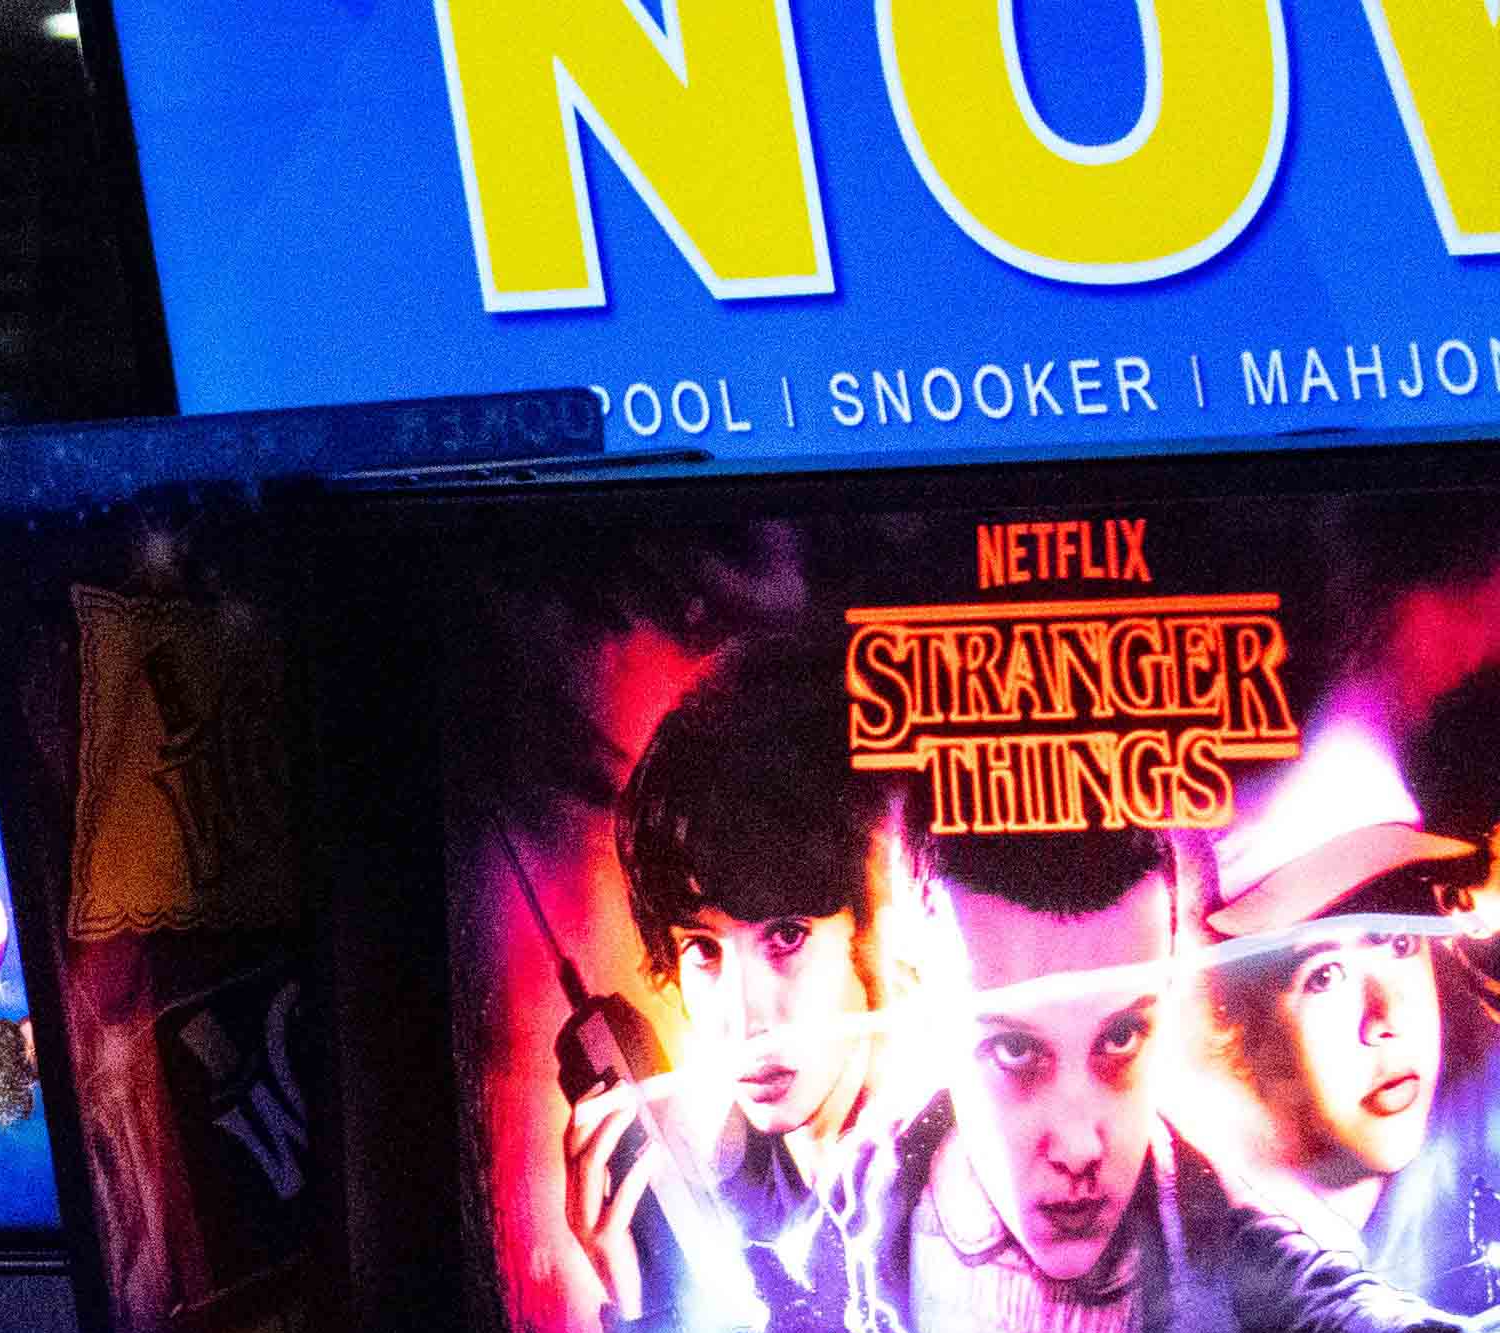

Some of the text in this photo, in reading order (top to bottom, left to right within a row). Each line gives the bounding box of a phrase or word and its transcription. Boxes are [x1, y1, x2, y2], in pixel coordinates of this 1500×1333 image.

[434, 0, 1500, 313] NO
[830, 355, 1159, 429] SNOOKER
[1240, 336, 1500, 407] MAHJO
[977, 519, 1151, 589] NETFLIX
[846, 615, 1298, 750] STRANGER
[920, 729, 1236, 836] THINGS
